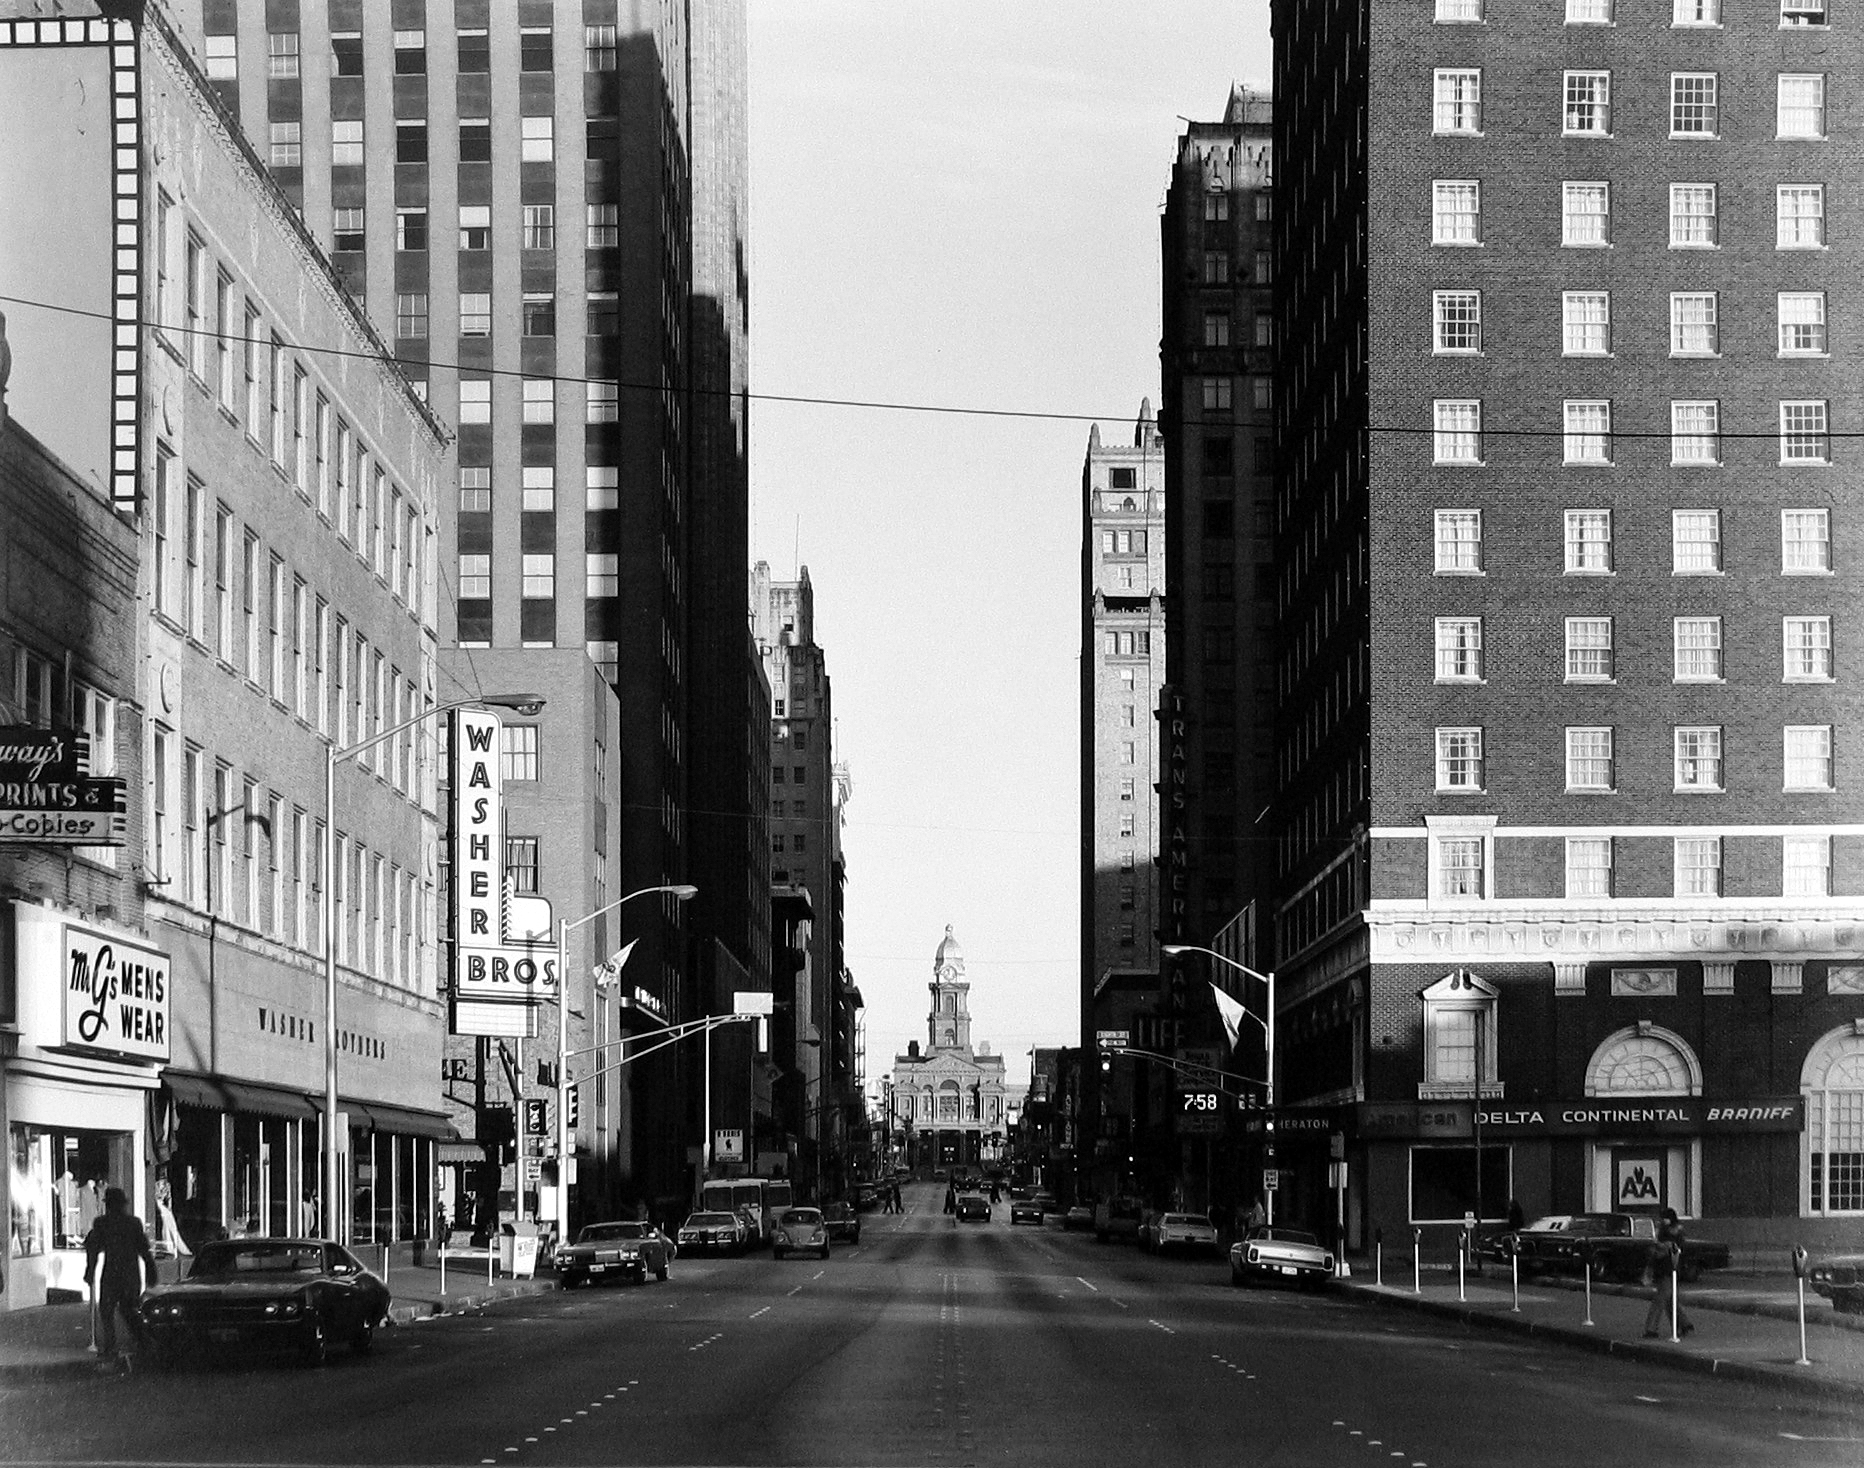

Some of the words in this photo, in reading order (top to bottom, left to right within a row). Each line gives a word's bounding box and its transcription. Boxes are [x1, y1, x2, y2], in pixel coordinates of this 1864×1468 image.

[1171, 694, 1185, 809] TRANS
[466, 724, 494, 935] WASHER
[1170, 830, 1187, 1010] AMERIAN
[121, 961, 164, 1003] MENS
[468, 954, 556, 985] BROS
[121, 1004, 165, 1045] WEAR
[258, 1006, 315, 1043] WASHER
[335, 1028, 385, 1060] ROTHERS
[1184, 1093, 1217, 1111] 7:58
[1474, 1111, 1545, 1125] DELTA
[1562, 1108, 1690, 1123] CONTINENTAL
[1706, 1107, 1795, 1121] BRANIFF
